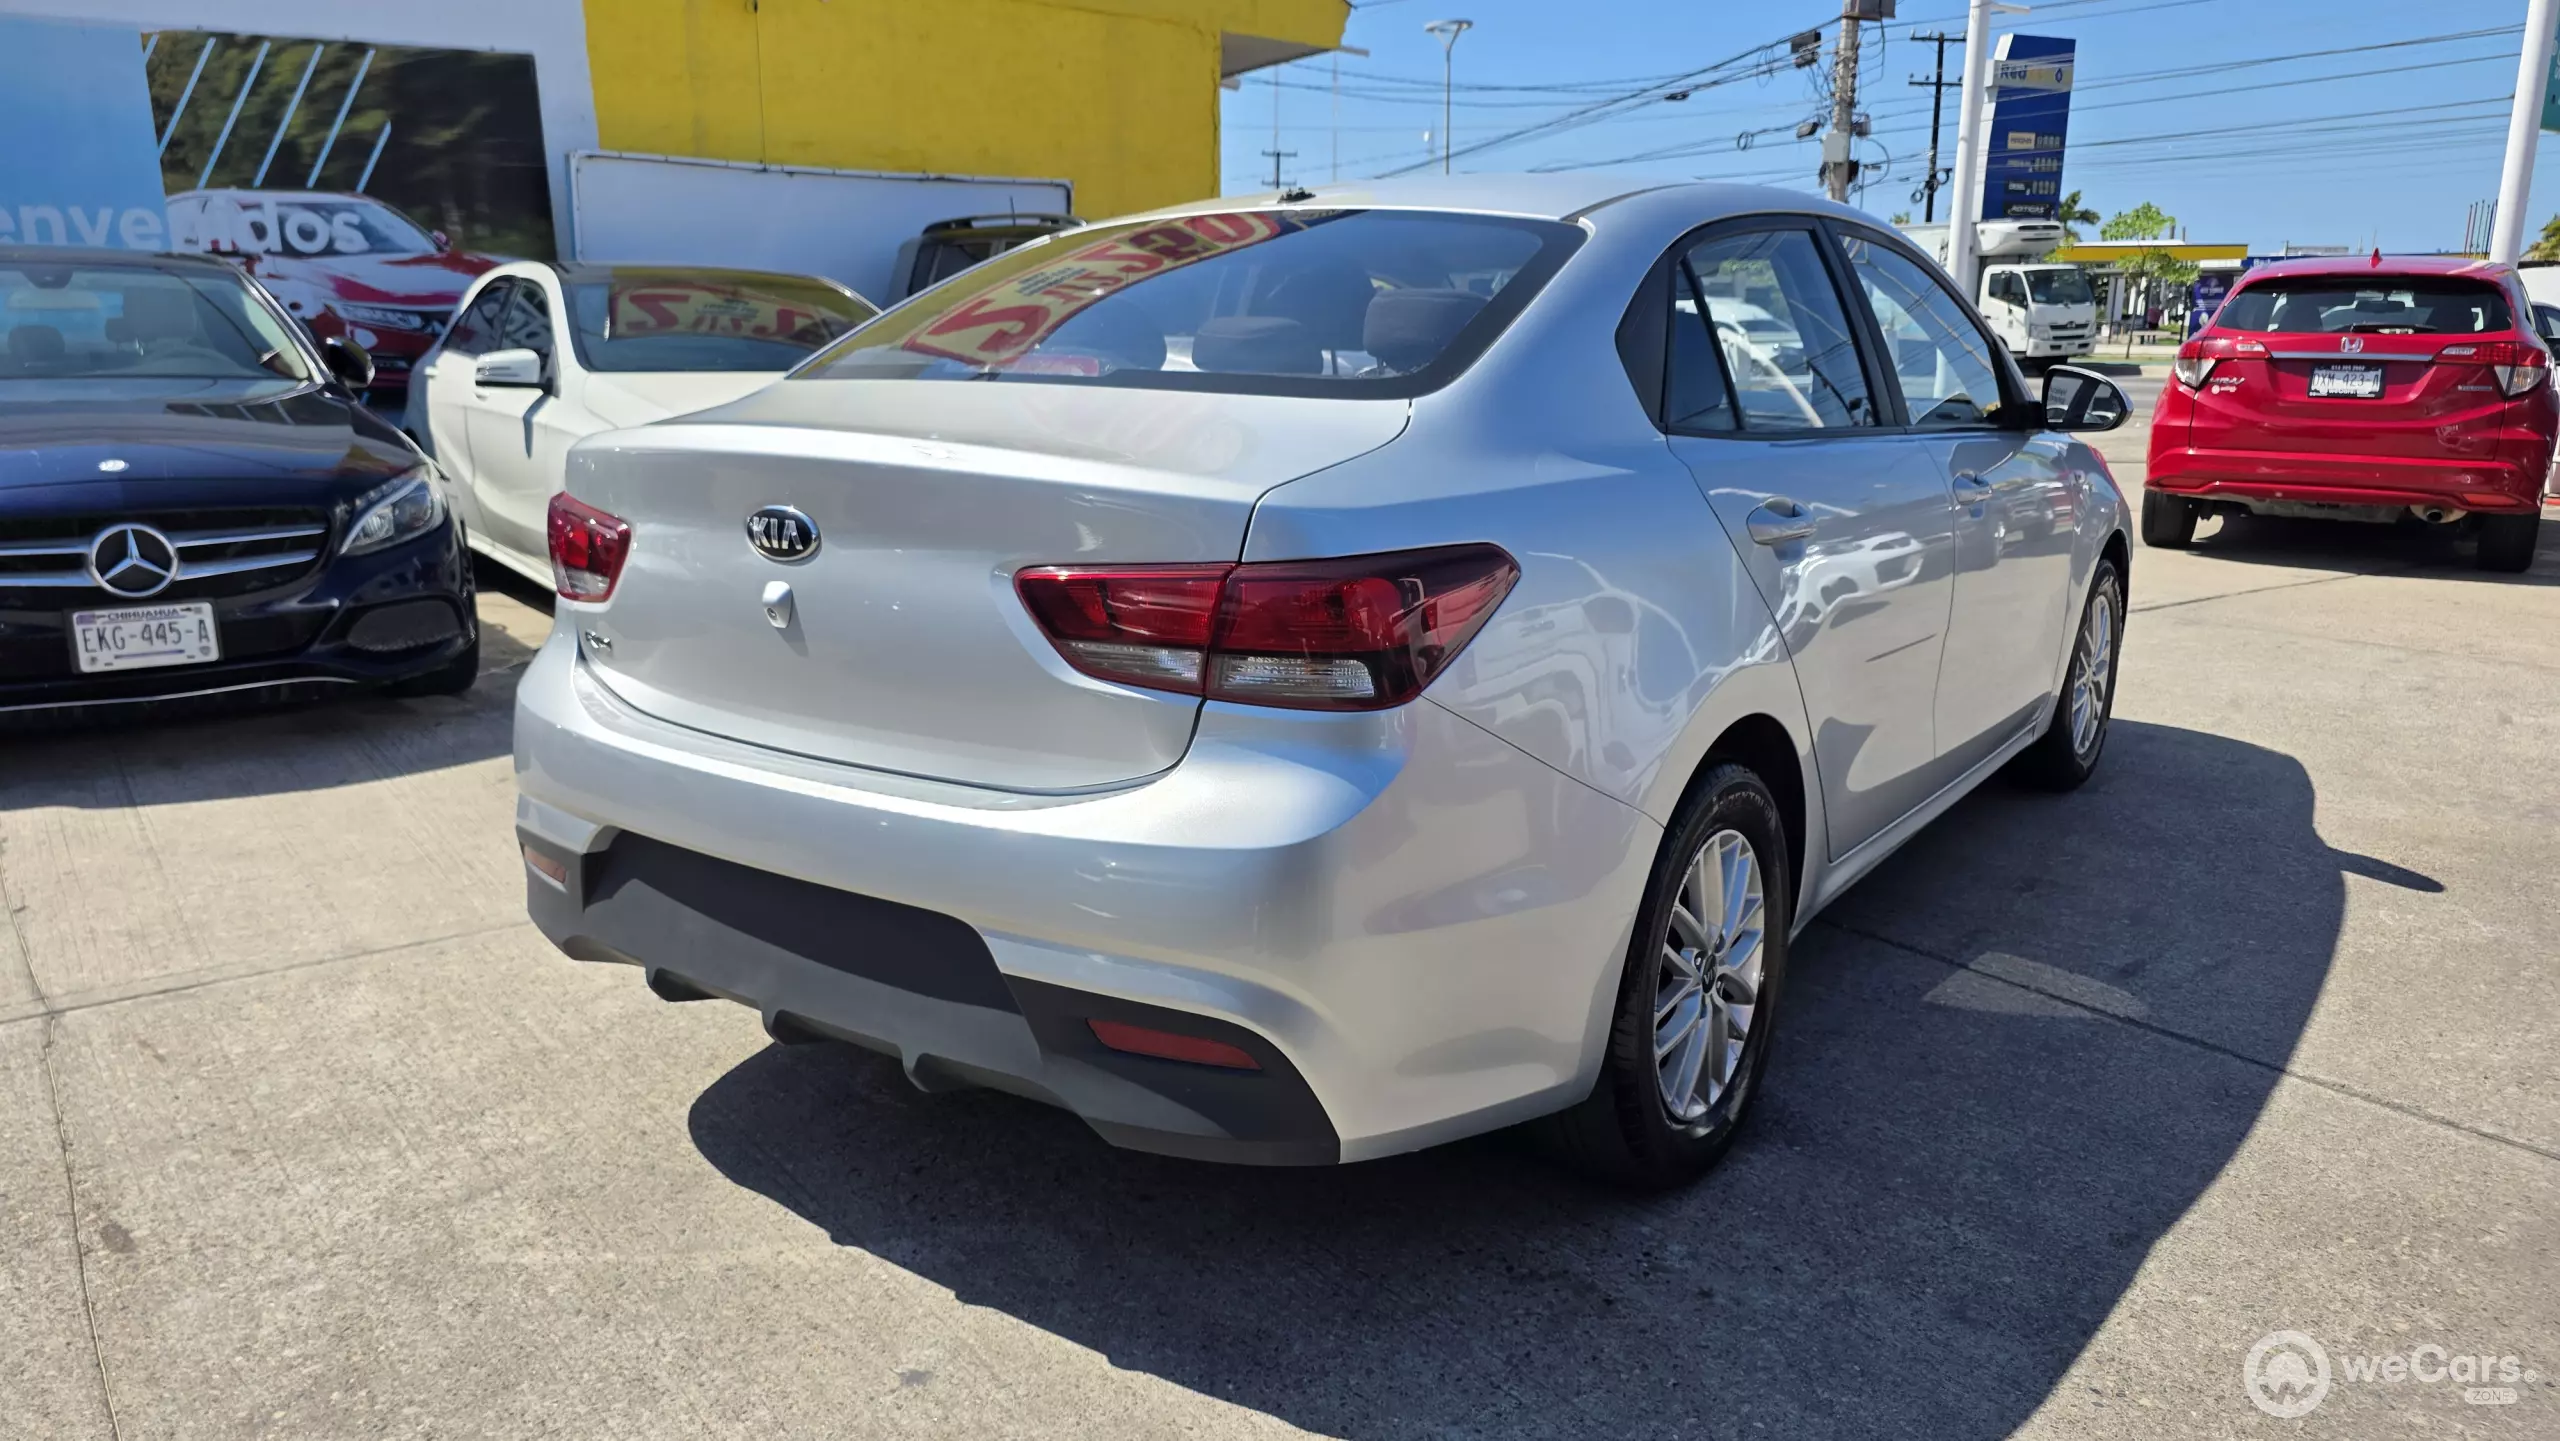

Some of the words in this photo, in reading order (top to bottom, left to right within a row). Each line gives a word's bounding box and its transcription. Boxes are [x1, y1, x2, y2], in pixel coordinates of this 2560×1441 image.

[752, 516, 804, 551] KIA
[107, 608, 180, 621] CHIHUAHUA
[82, 618, 211, 653] EKG-445-A
